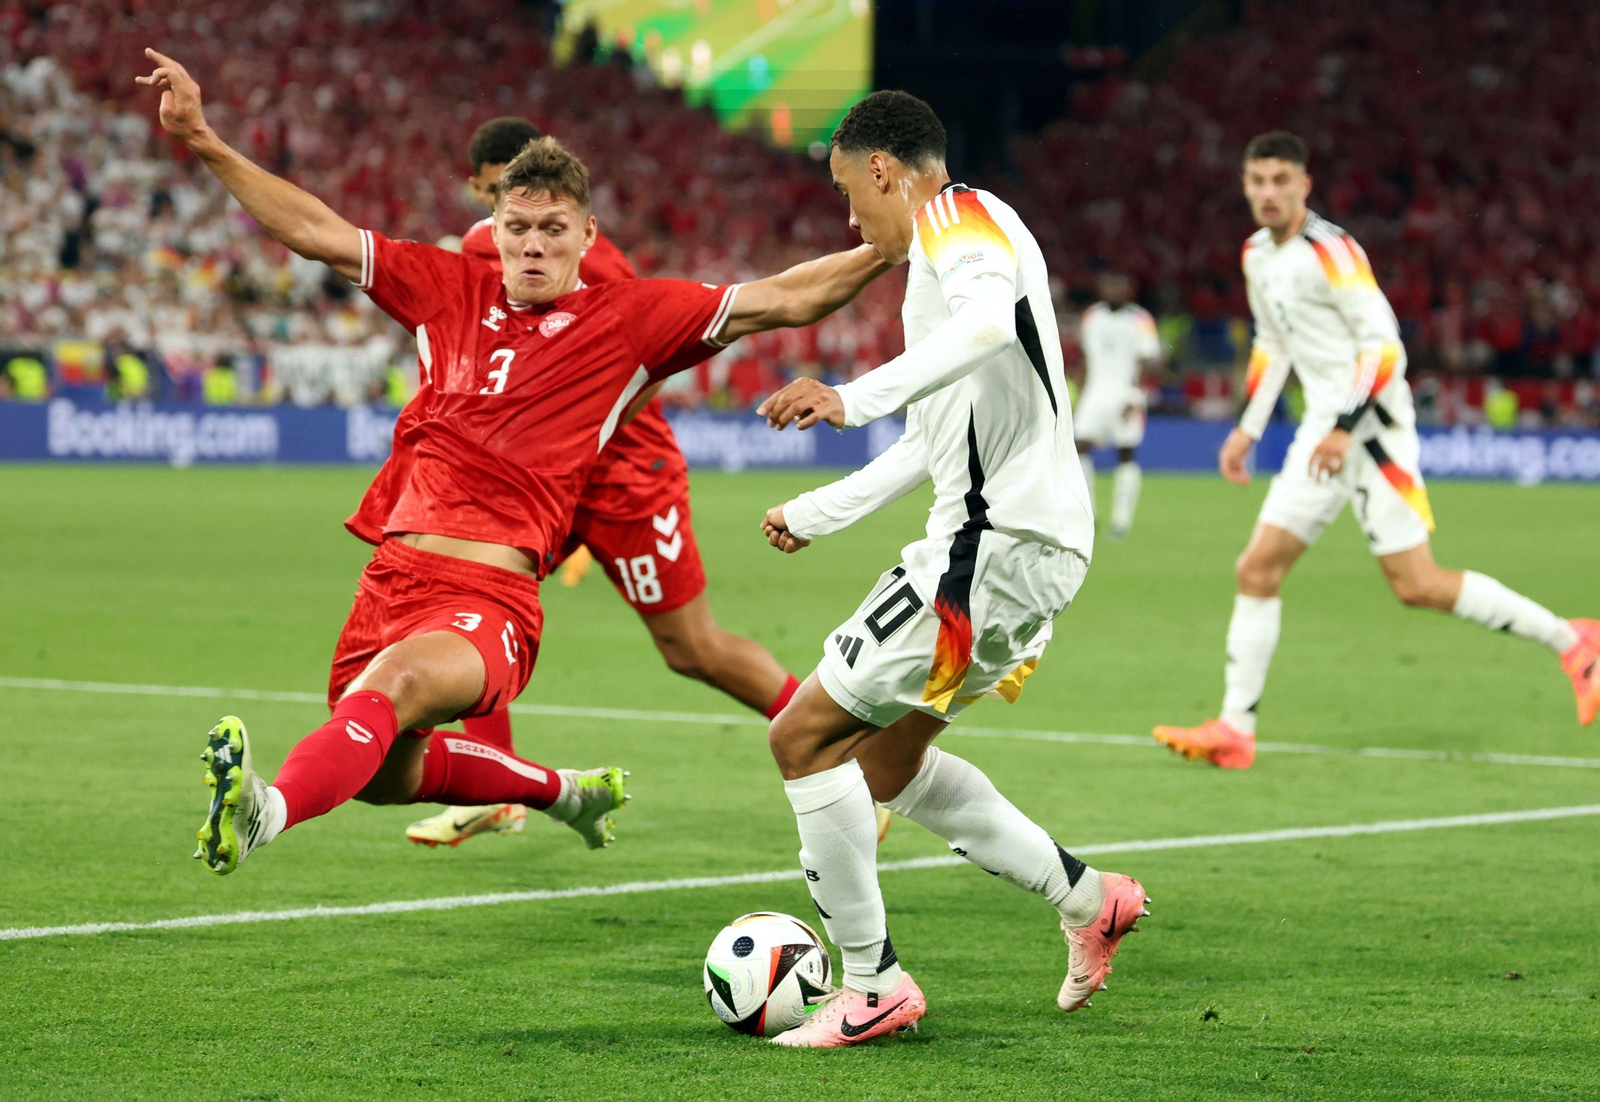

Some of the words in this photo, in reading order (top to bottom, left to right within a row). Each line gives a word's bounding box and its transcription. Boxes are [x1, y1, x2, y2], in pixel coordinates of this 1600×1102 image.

[479, 348, 516, 395] 3
[48, 400, 278, 467] Booking.com
[614, 554, 663, 604] 18
[451, 612, 482, 632] 3
